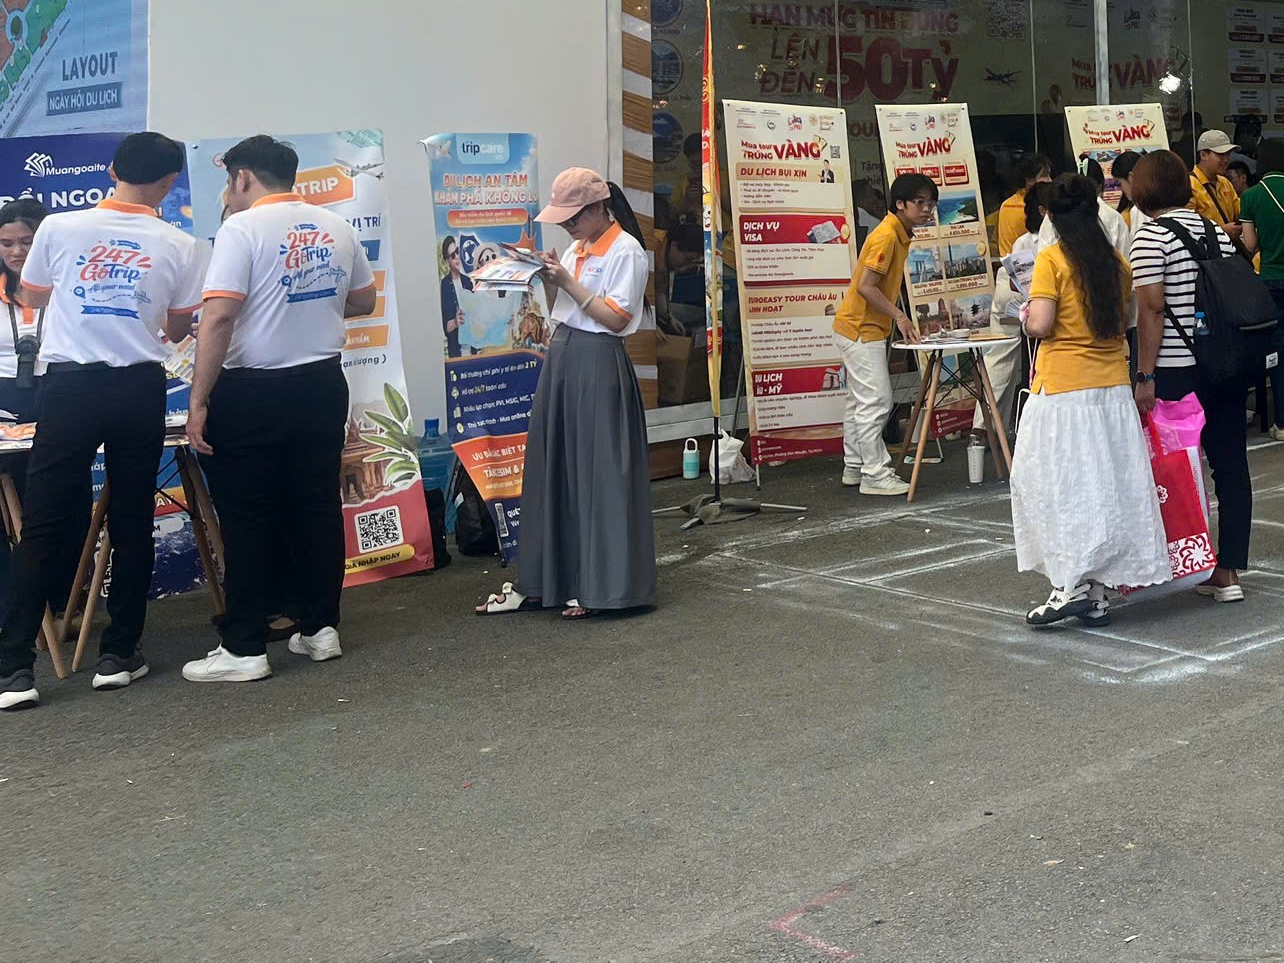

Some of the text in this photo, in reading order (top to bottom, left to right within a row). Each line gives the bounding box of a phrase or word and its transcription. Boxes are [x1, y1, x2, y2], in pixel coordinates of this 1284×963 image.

[62, 51, 118, 81] LAYOUT
[86, 92, 97, 107] DU
[100, 89, 118, 108] LỊCH
[1112, 125, 1151, 142] VÀNG
[773, 139, 821, 159] VÀNG
[917, 137, 951, 157] VÀNG
[485, 175, 502, 188] AN
[505, 171, 529, 187] TÂM
[740, 167, 754, 176] DU
[743, 221, 764, 232] DỊCH
[287, 231, 319, 250] 247
[744, 233, 763, 242] VISA
[88, 245, 141, 264] 247
[80, 263, 142, 283] GoTrip
[785, 295, 806, 303] TOUR
[380, 551, 401, 562] NGAY
